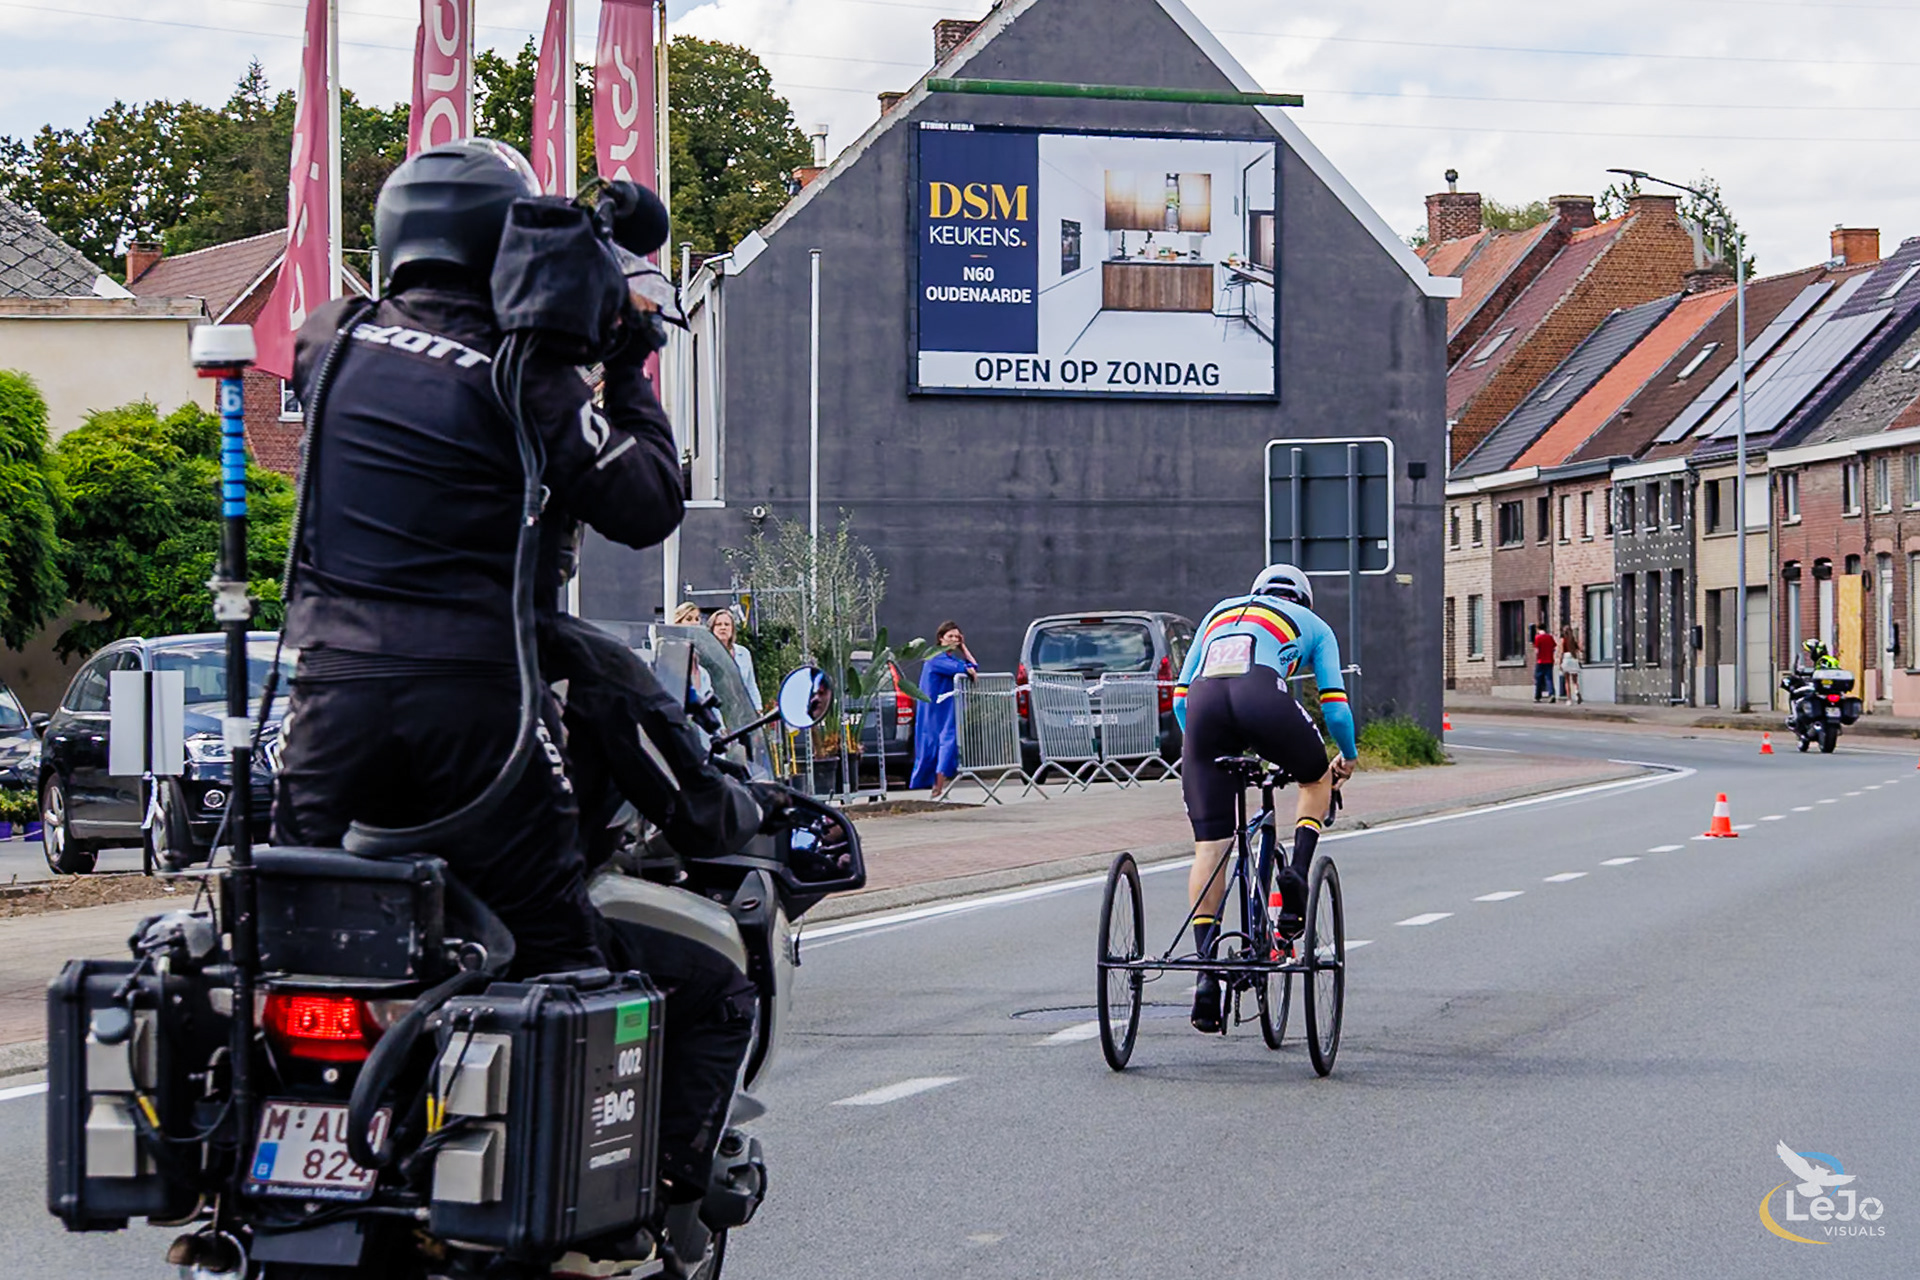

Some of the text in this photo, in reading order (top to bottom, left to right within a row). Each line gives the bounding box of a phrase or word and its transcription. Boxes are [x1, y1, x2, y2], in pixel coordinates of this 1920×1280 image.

[929, 181, 1028, 221] DSM
[929, 225, 1027, 247] KEUKENS.
[963, 266, 995, 282] N60
[925, 286, 1032, 304] OUDENAARDE
[352, 323, 492, 368] SCOTT
[975, 357, 1220, 386] OPEN OP ZONDAG
[221, 385, 242, 412] 6
[1211, 642, 1246, 666] 322
[618, 1046, 643, 1077] 002
[603, 1088, 636, 1127] EMG
